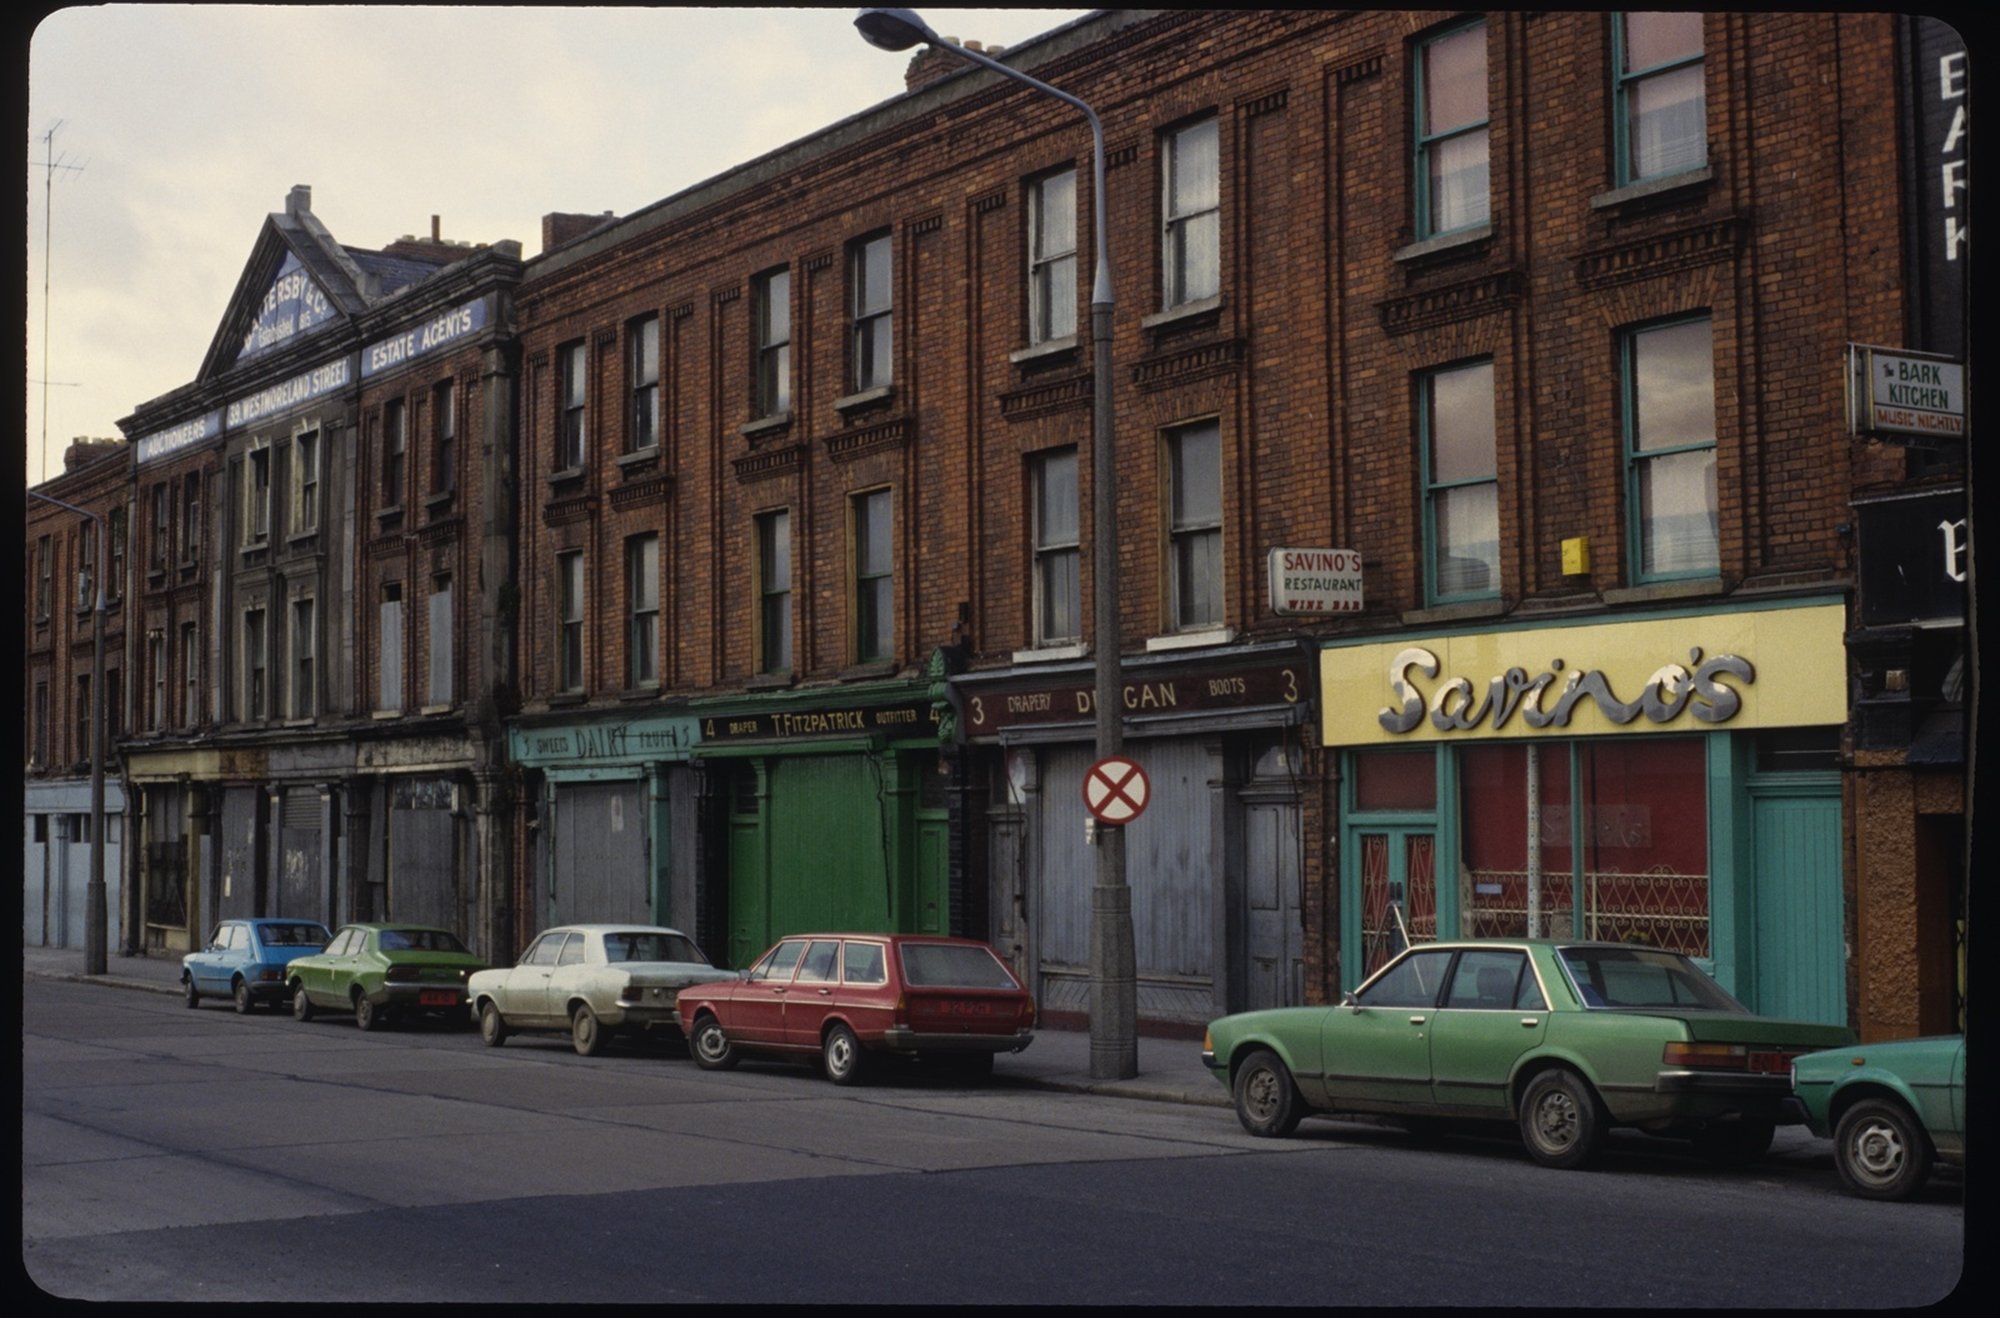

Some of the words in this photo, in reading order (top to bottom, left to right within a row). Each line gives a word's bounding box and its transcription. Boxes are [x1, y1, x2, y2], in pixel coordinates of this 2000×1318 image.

[371, 334, 415, 371] ESTATE
[421, 309, 472, 351] AGENTS
[1899, 361, 1941, 386] BARK
[242, 374, 311, 421] WESTMORELAND
[312, 359, 349, 393] STREET
[1888, 383, 1949, 409] KITCHEN
[1876, 408, 1915, 427] MUSIC
[1917, 413, 1962, 432] NIGHTLY
[147, 419, 206, 458] AUCTIONEERS
[1284, 552, 1361, 573] SAVINO'S
[1284, 577, 1362, 592] RESTAURANT
[1288, 600, 1323, 611] WINE
[1332, 600, 1360, 611] BAR
[971, 696, 986, 726] 3
[1008, 693, 1050, 714] DRAPERY
[1076, 682, 1177, 713] DGAN
[1208, 677, 1246, 697] BOOTS
[1281, 669, 1299, 703] 3
[1378, 646, 1755, 735] Savino's
[705, 718, 716, 738] 4
[729, 720, 758, 735] DRAPER
[875, 709, 918, 726] OUTFITTER
[536, 737, 569, 755] SWEETS
[574, 726, 628, 760] DAIRY
[639, 730, 671, 749] FRUIT
